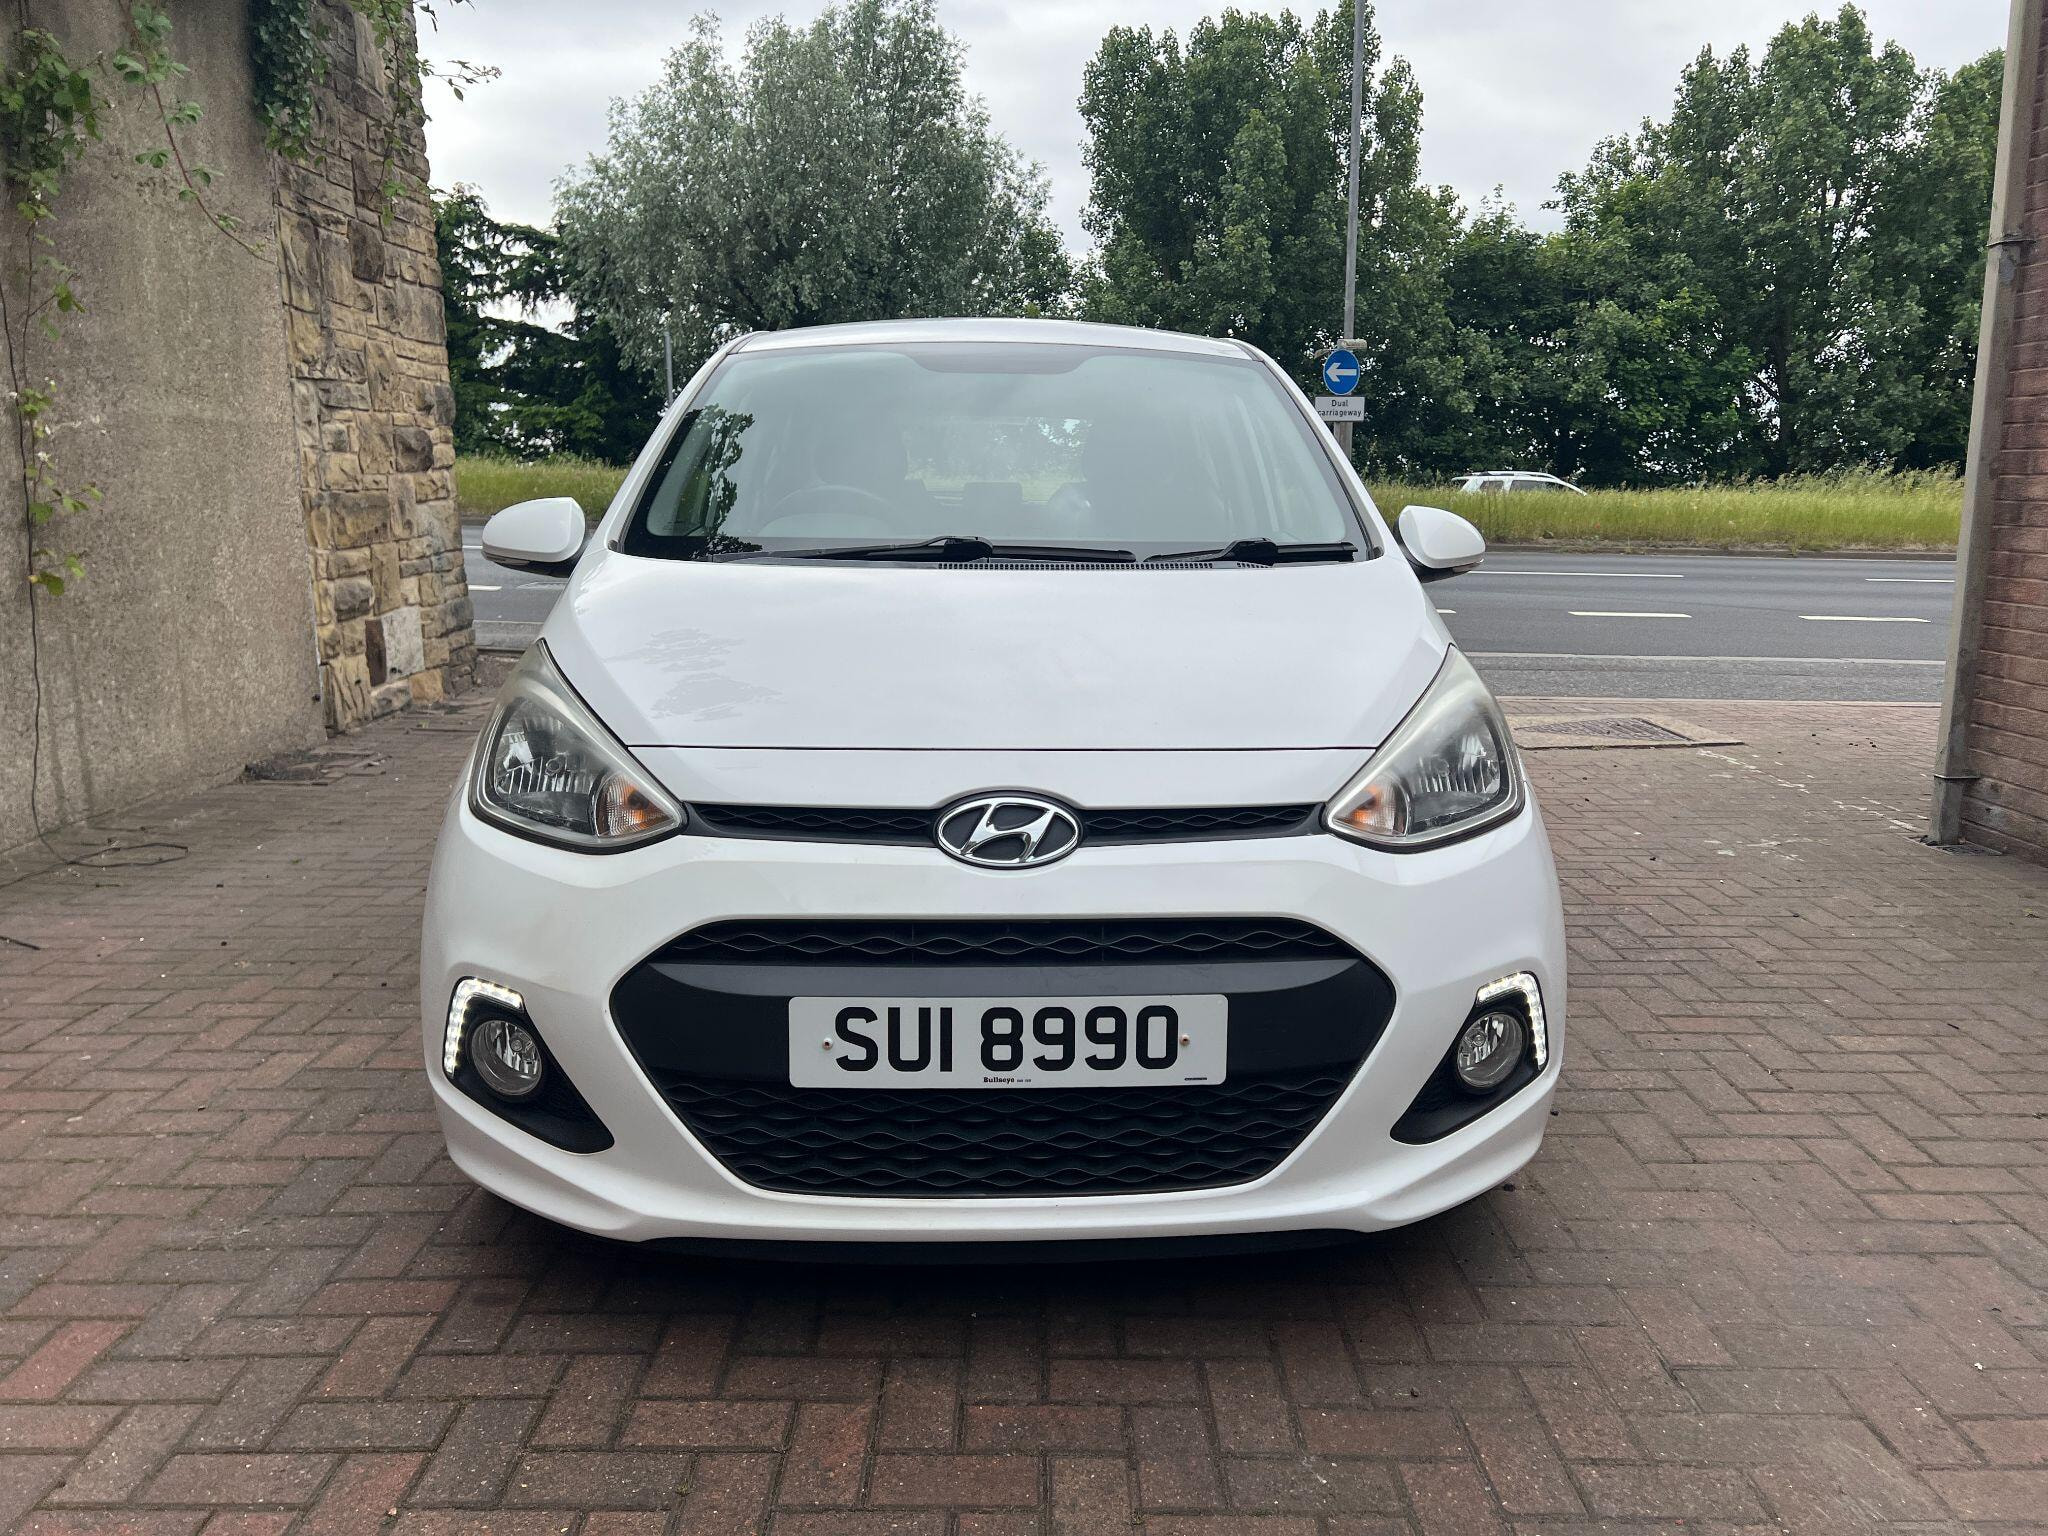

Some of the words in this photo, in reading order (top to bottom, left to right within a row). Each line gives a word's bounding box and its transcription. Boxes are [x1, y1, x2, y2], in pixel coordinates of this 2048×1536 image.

[1318, 409, 1362, 417] carriageway
[835, 1006, 953, 1073] SUI
[980, 1005, 1179, 1073] 8990
[983, 1076, 1015, 1084] Bullseye
